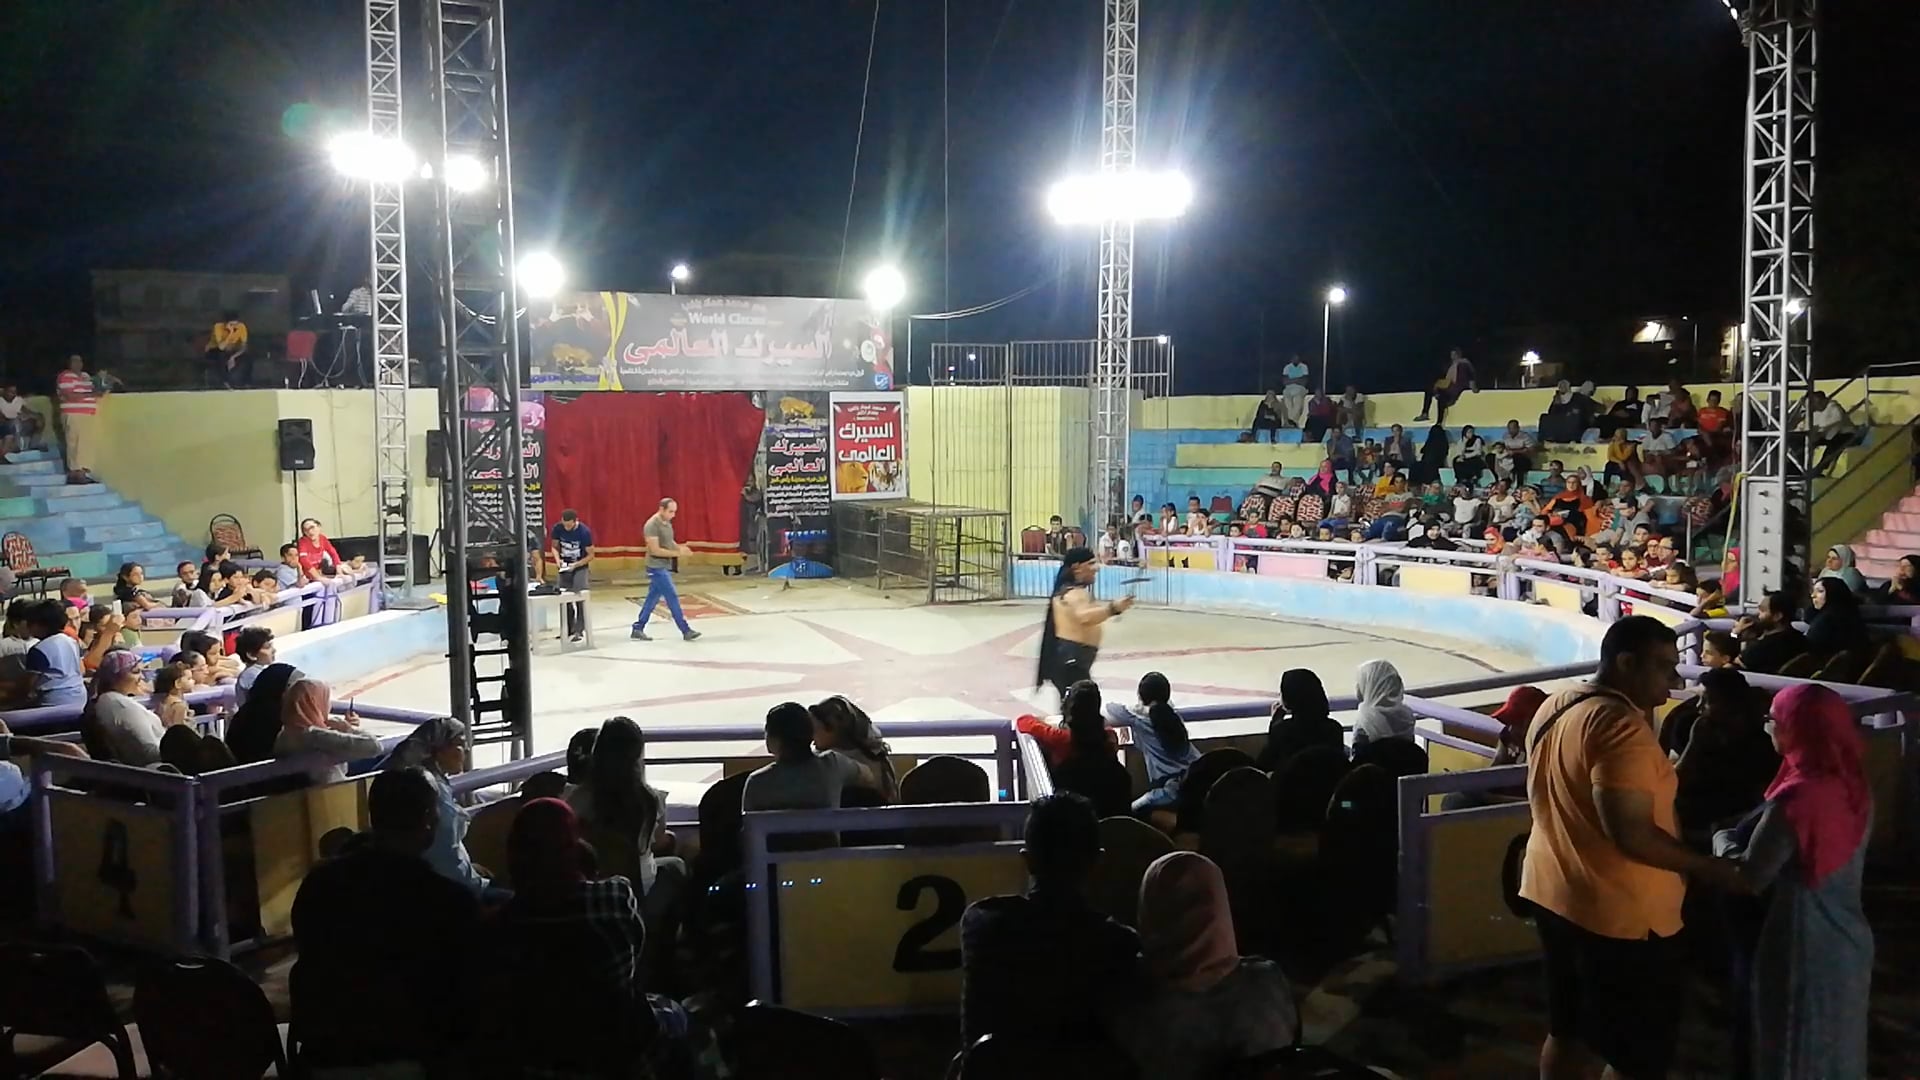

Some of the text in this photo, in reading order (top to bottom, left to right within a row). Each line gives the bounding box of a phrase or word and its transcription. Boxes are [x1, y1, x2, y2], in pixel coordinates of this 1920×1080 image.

[688, 311, 725, 325] World
[735, 329, 833, 366] السيرك
[839, 421, 894, 444] السيرك
[770, 437, 828, 457] السيرك
[893, 874, 967, 973] 2
